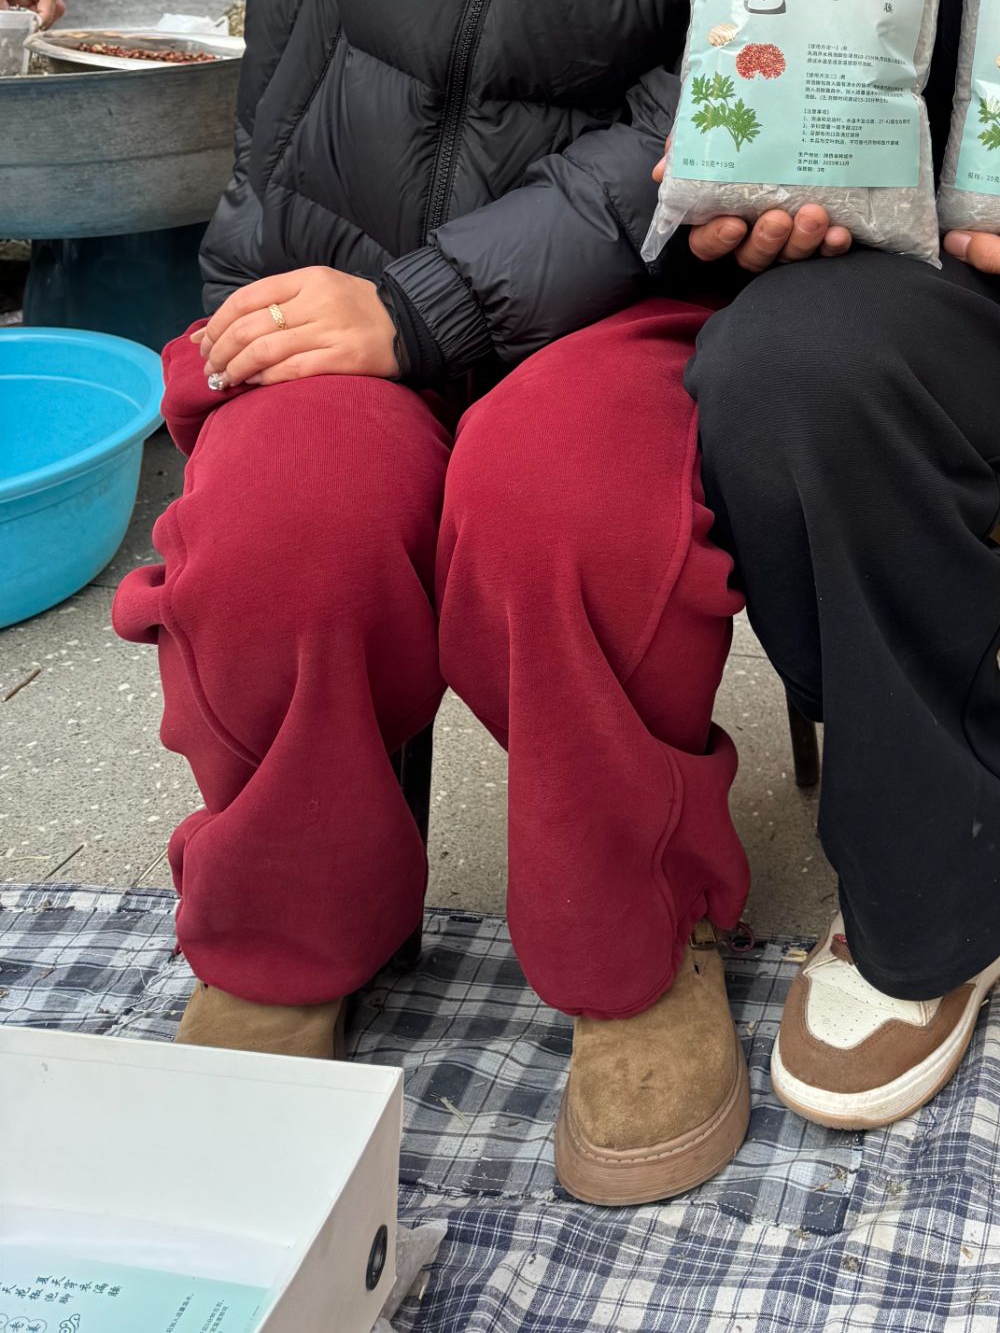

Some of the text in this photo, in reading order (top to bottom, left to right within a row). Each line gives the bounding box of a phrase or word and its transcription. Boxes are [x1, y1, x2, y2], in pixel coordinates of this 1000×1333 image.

[0, 1282, 73, 1304] 天花椒泡脚
